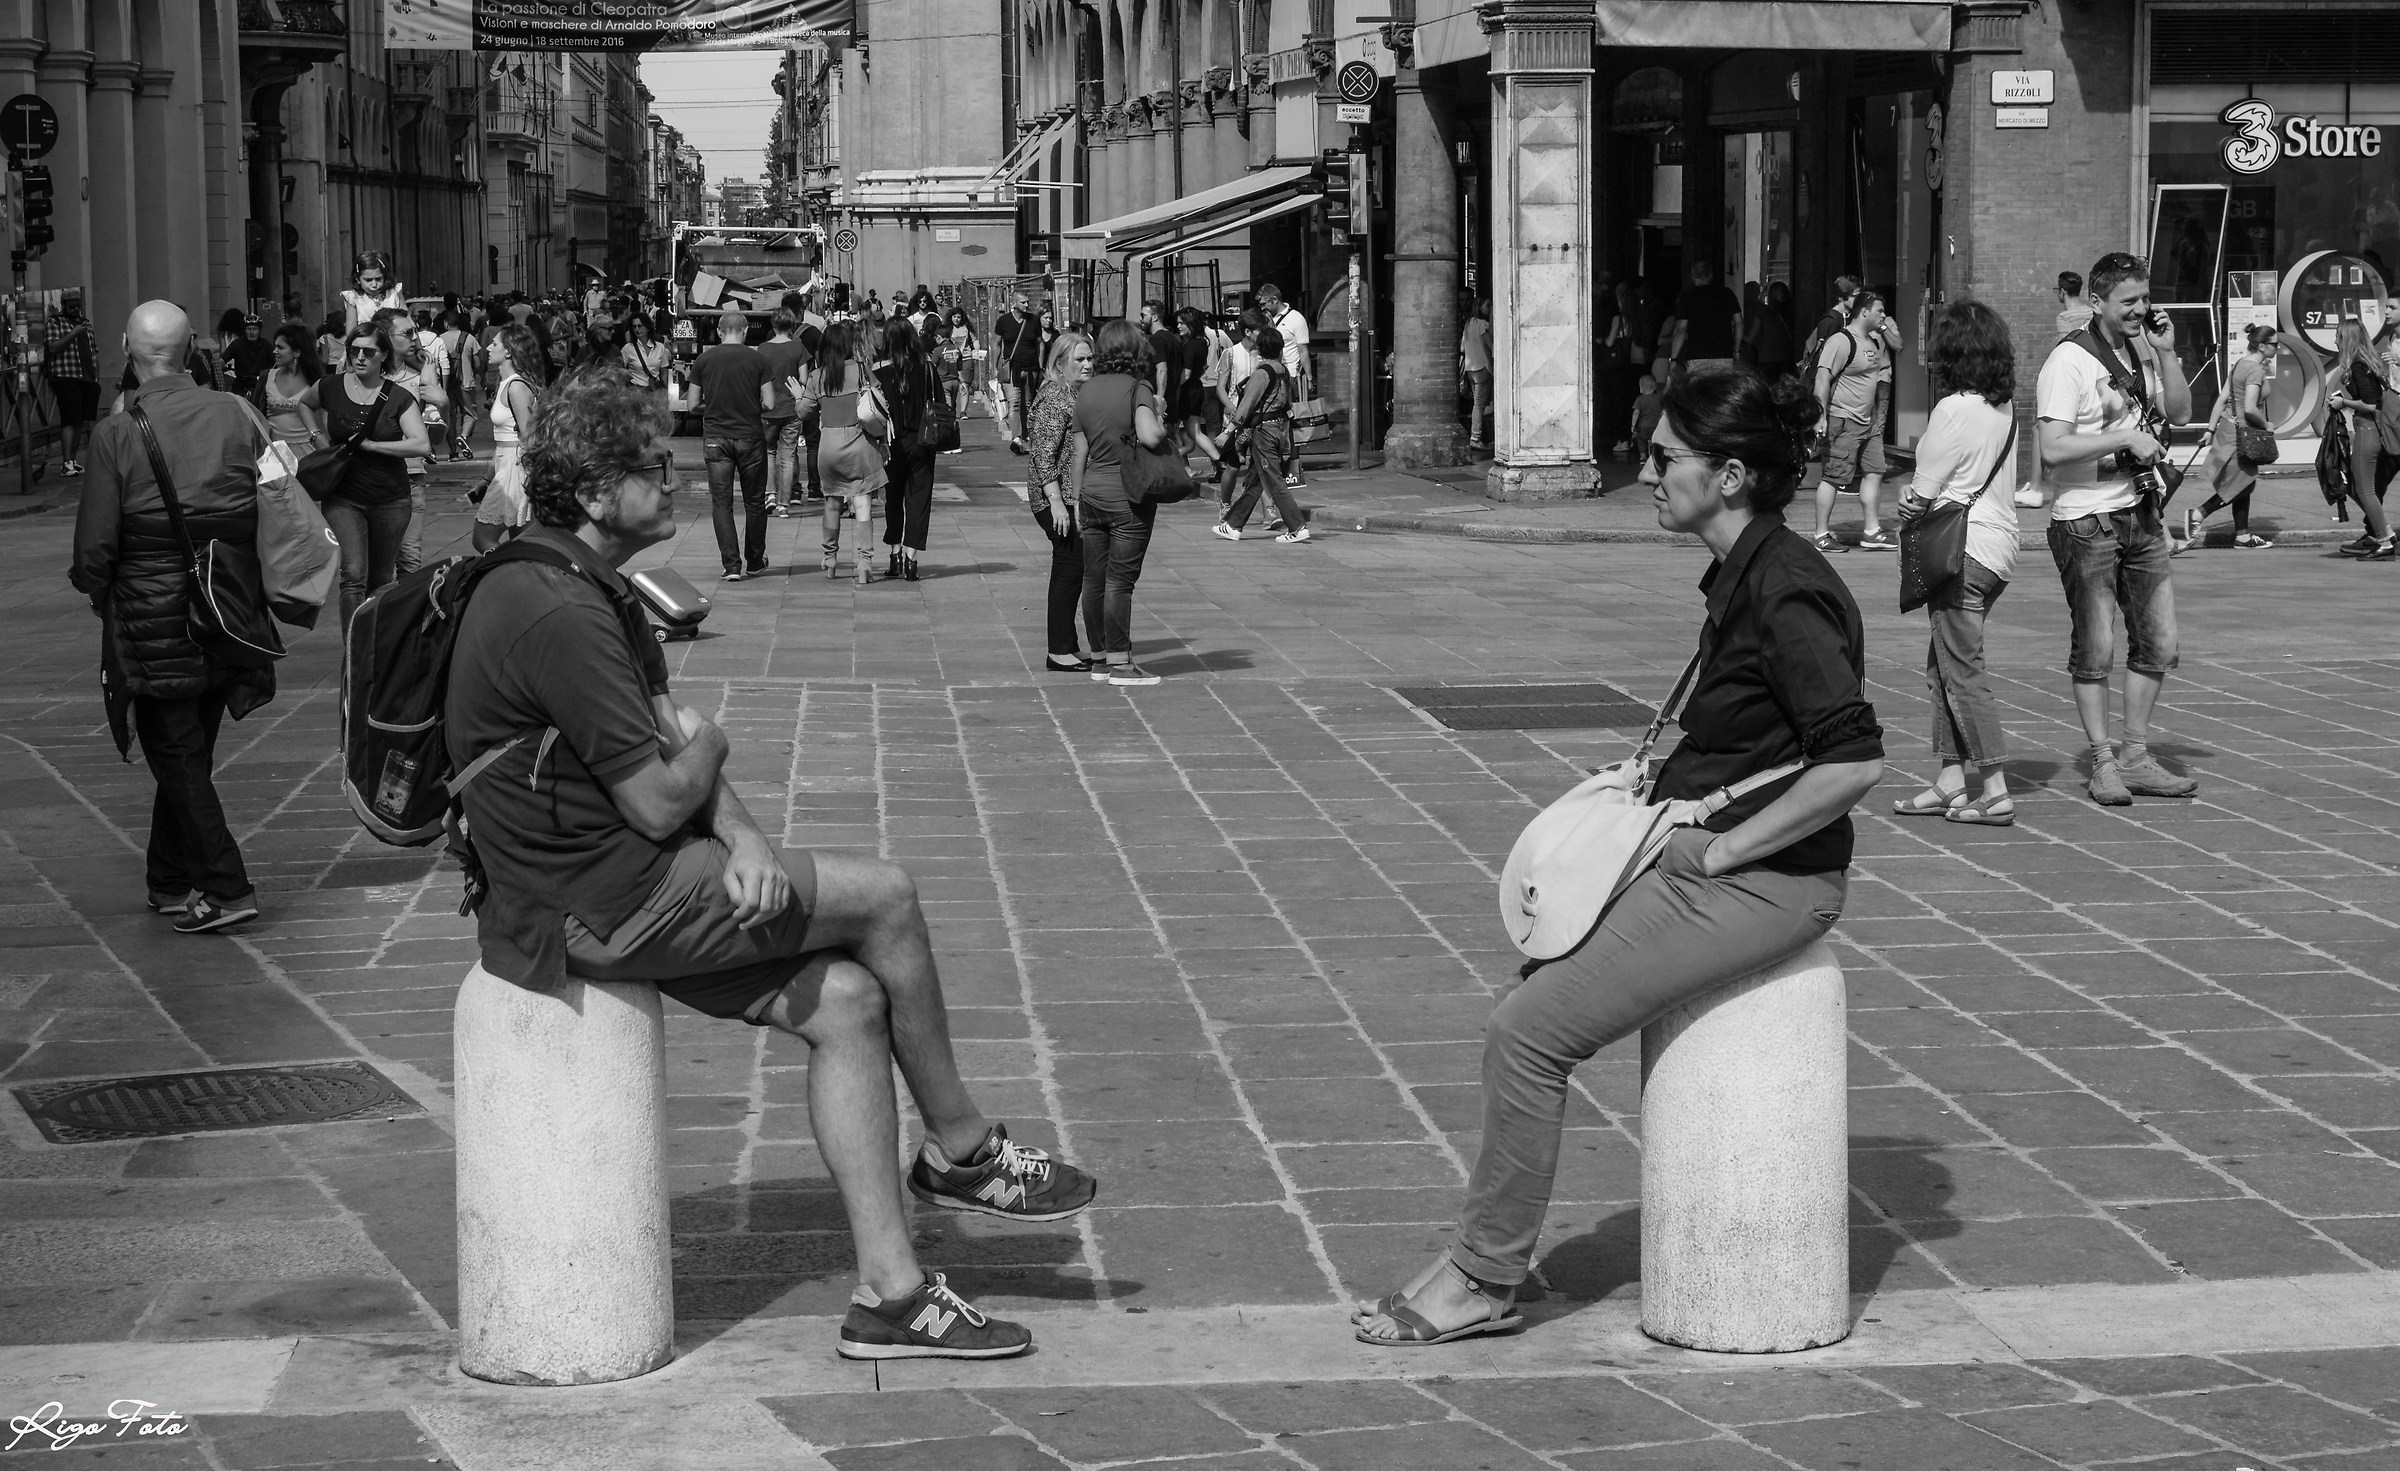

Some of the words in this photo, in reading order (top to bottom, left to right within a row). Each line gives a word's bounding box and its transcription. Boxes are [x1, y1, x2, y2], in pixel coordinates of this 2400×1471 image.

[480, 1, 497, 14] La
[502, 2, 568, 18] passione
[572, 1, 587, 16] di
[590, 2, 668, 18] Cleopatra
[479, 16, 517, 29] Visioni
[520, 20, 529, 28] e
[531, 18, 587, 30] maschere
[590, 19, 602, 30] di
[604, 18, 652, 30] Arnaldo
[655, 18, 716, 30] Pomodoro
[480, 35, 493, 44] 24
[494, 35, 529, 46] giugno
[535, 36, 546, 45] 18
[549, 35, 599, 46] settembre
[601, 36, 625, 47] 2016
[2015, 76, 2030, 85] VIA
[2005, 88, 2041, 97] RIZZOLI
[2224, 99, 2281, 174] 3
[2284, 117, 2382, 157] Store
[2305, 311, 2322, 324] S7
[681, 321, 690, 329] ZA
[1285, 473, 1298, 484] oin
[910, 1303, 957, 1338] N
